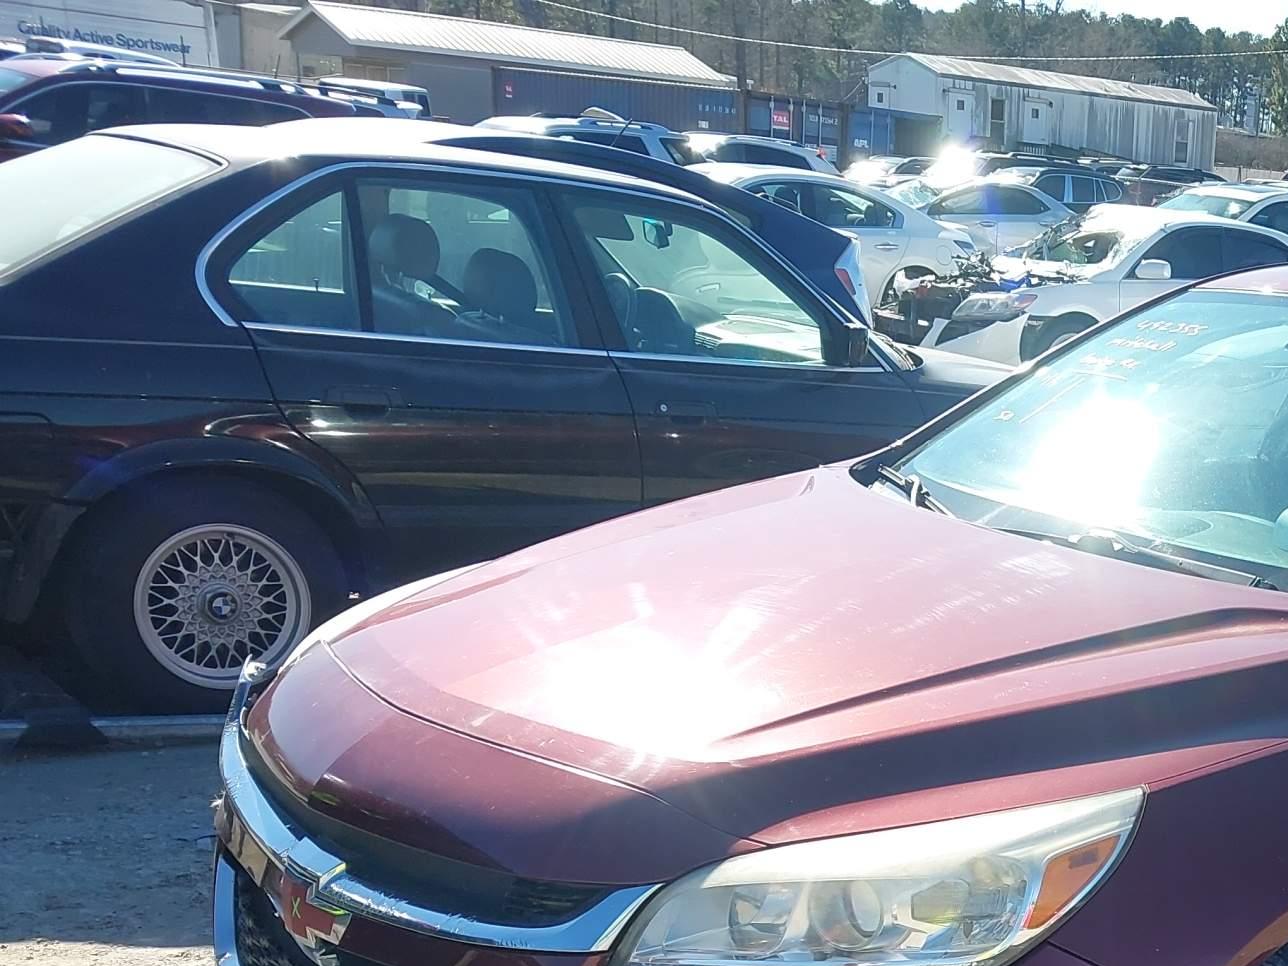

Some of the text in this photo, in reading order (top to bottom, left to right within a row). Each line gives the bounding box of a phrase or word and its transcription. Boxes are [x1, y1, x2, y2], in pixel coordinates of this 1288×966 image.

[17, 19, 192, 54] Quality Active Sportswear
[773, 114, 789, 124] TAL
